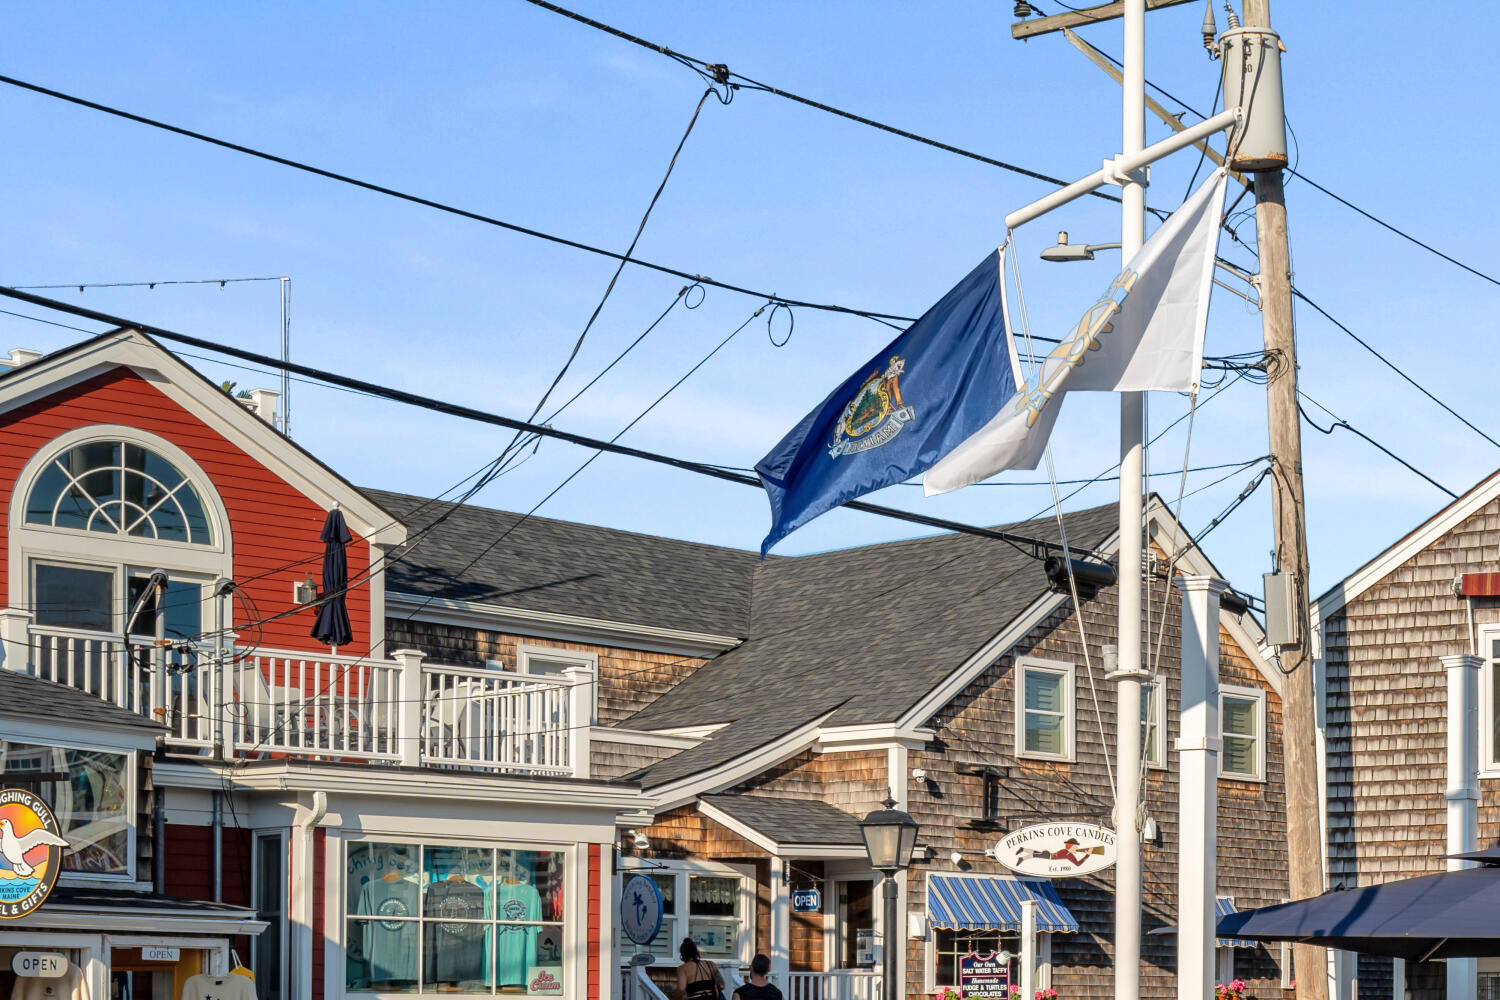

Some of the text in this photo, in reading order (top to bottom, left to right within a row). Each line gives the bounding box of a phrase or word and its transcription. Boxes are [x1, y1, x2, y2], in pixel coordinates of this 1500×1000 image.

[0, 791, 52, 829] GHING GULL
[1006, 826, 1116, 849] PERKINS COVE CANDIES
[21, 882, 49, 911] GIFTS
[794, 895, 817, 907] OPEN
[149, 950, 173, 959] OPEN
[23, 958, 57, 971] OPEN
[538, 970, 555, 982] Ice
